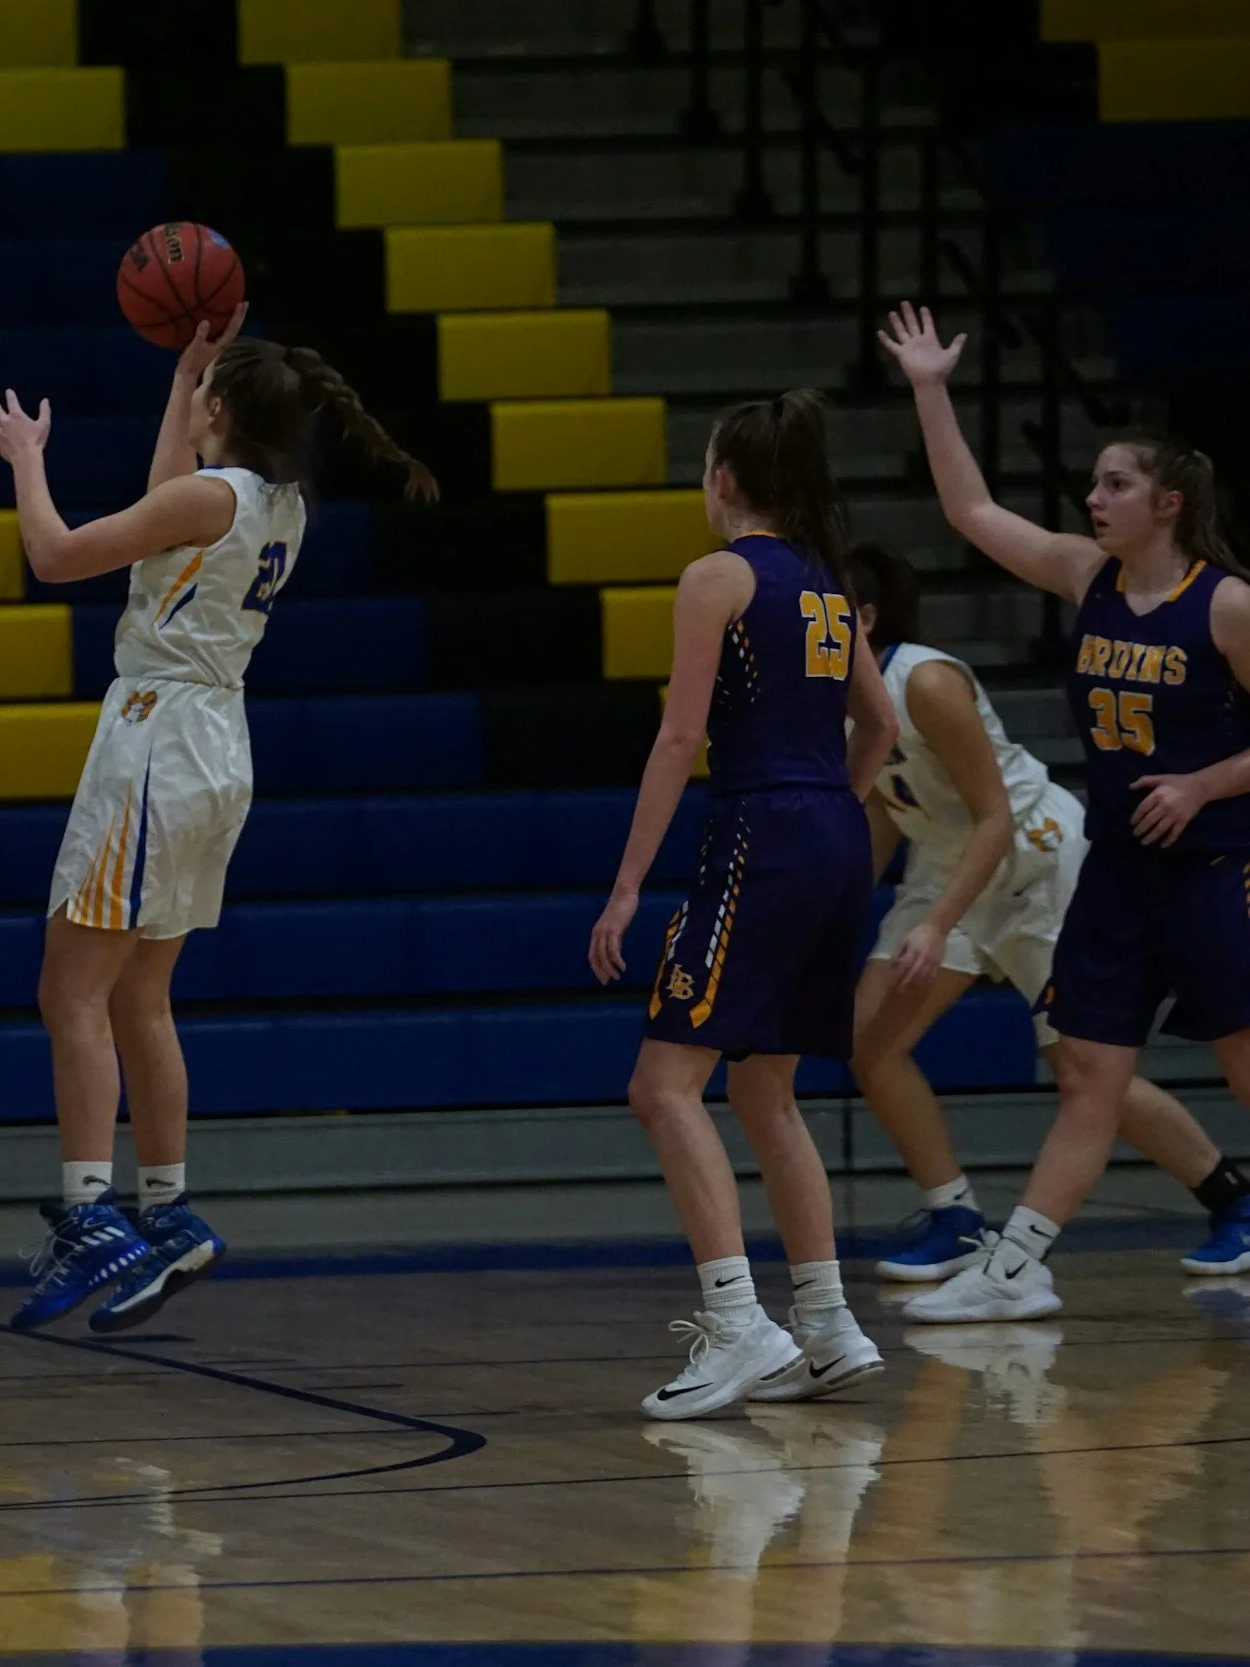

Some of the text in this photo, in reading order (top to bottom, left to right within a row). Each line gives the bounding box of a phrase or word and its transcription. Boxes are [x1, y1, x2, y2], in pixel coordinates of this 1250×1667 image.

[799, 590, 851, 681] 25
[1076, 633, 1189, 685] BRUINS
[1088, 687, 1156, 757] 35
